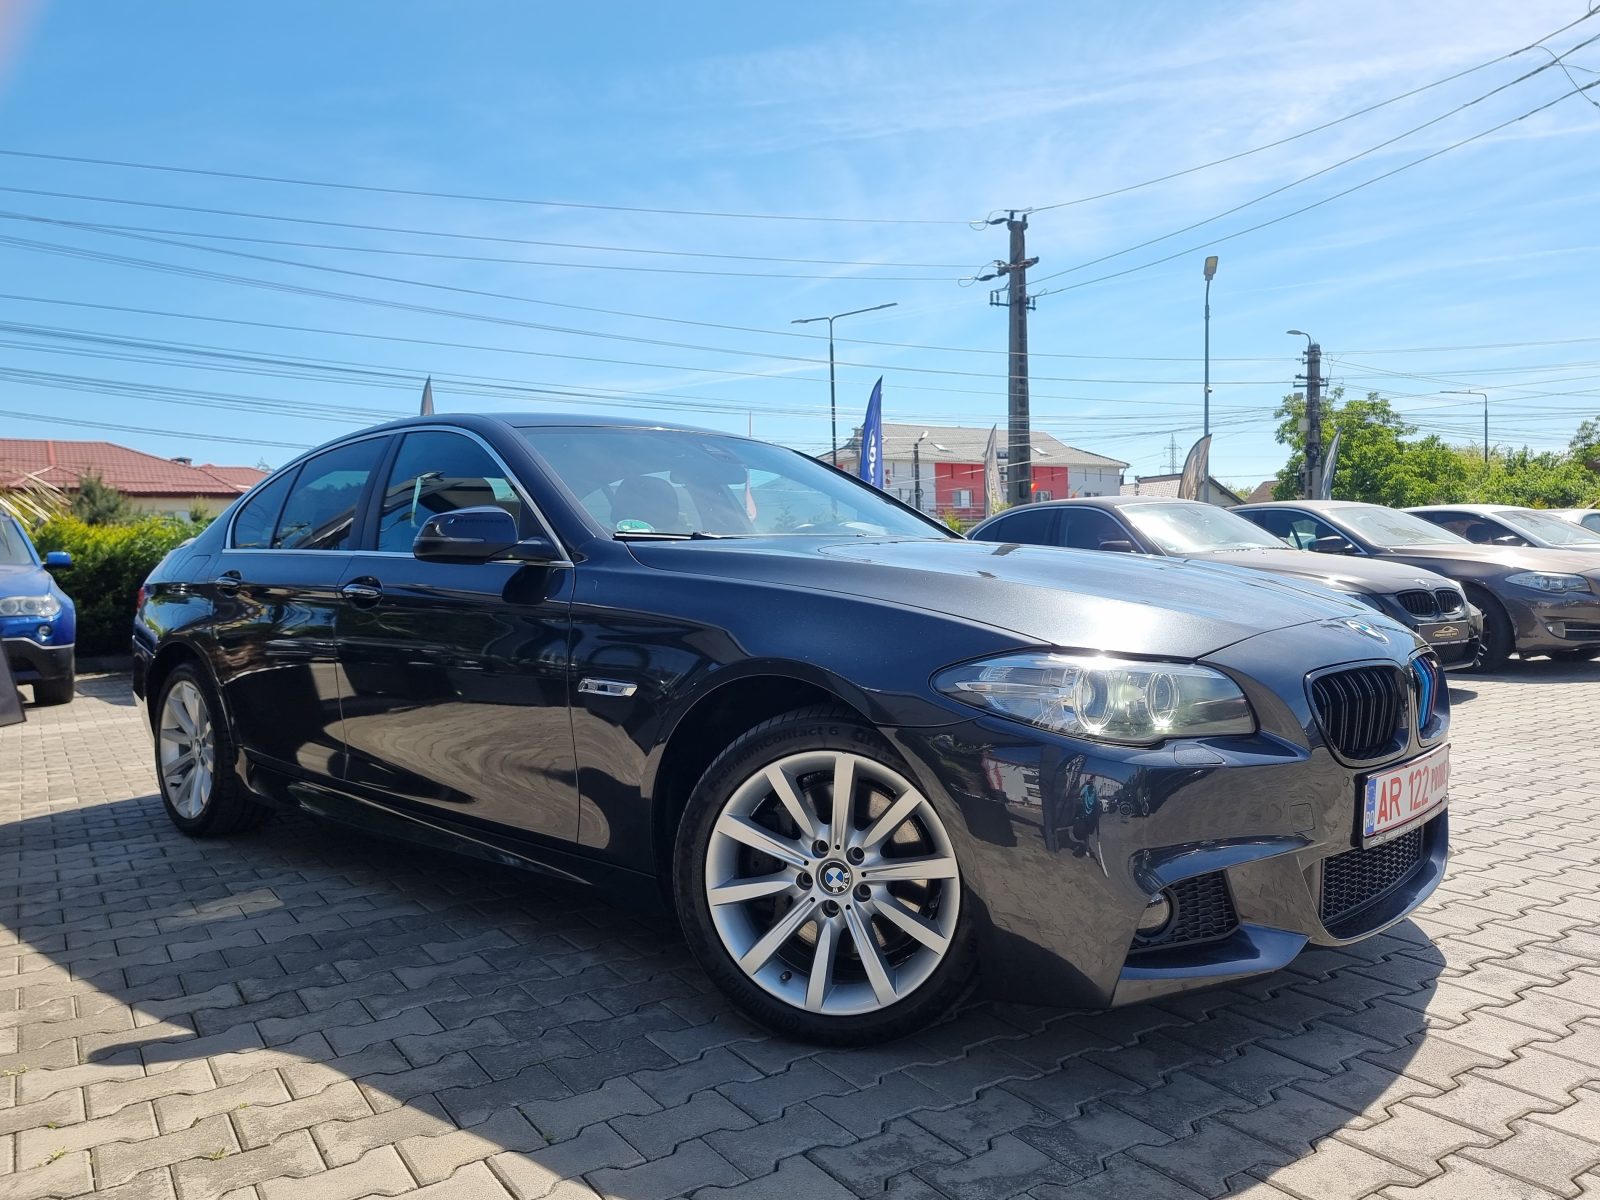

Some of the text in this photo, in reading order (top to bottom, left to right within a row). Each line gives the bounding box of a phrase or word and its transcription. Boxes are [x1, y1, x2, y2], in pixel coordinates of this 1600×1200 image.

[828, 726, 839, 736] 6
[1377, 777, 1402, 824] AR
[1409, 766, 1429, 811] 122
[1365, 810, 1375, 828] RO
